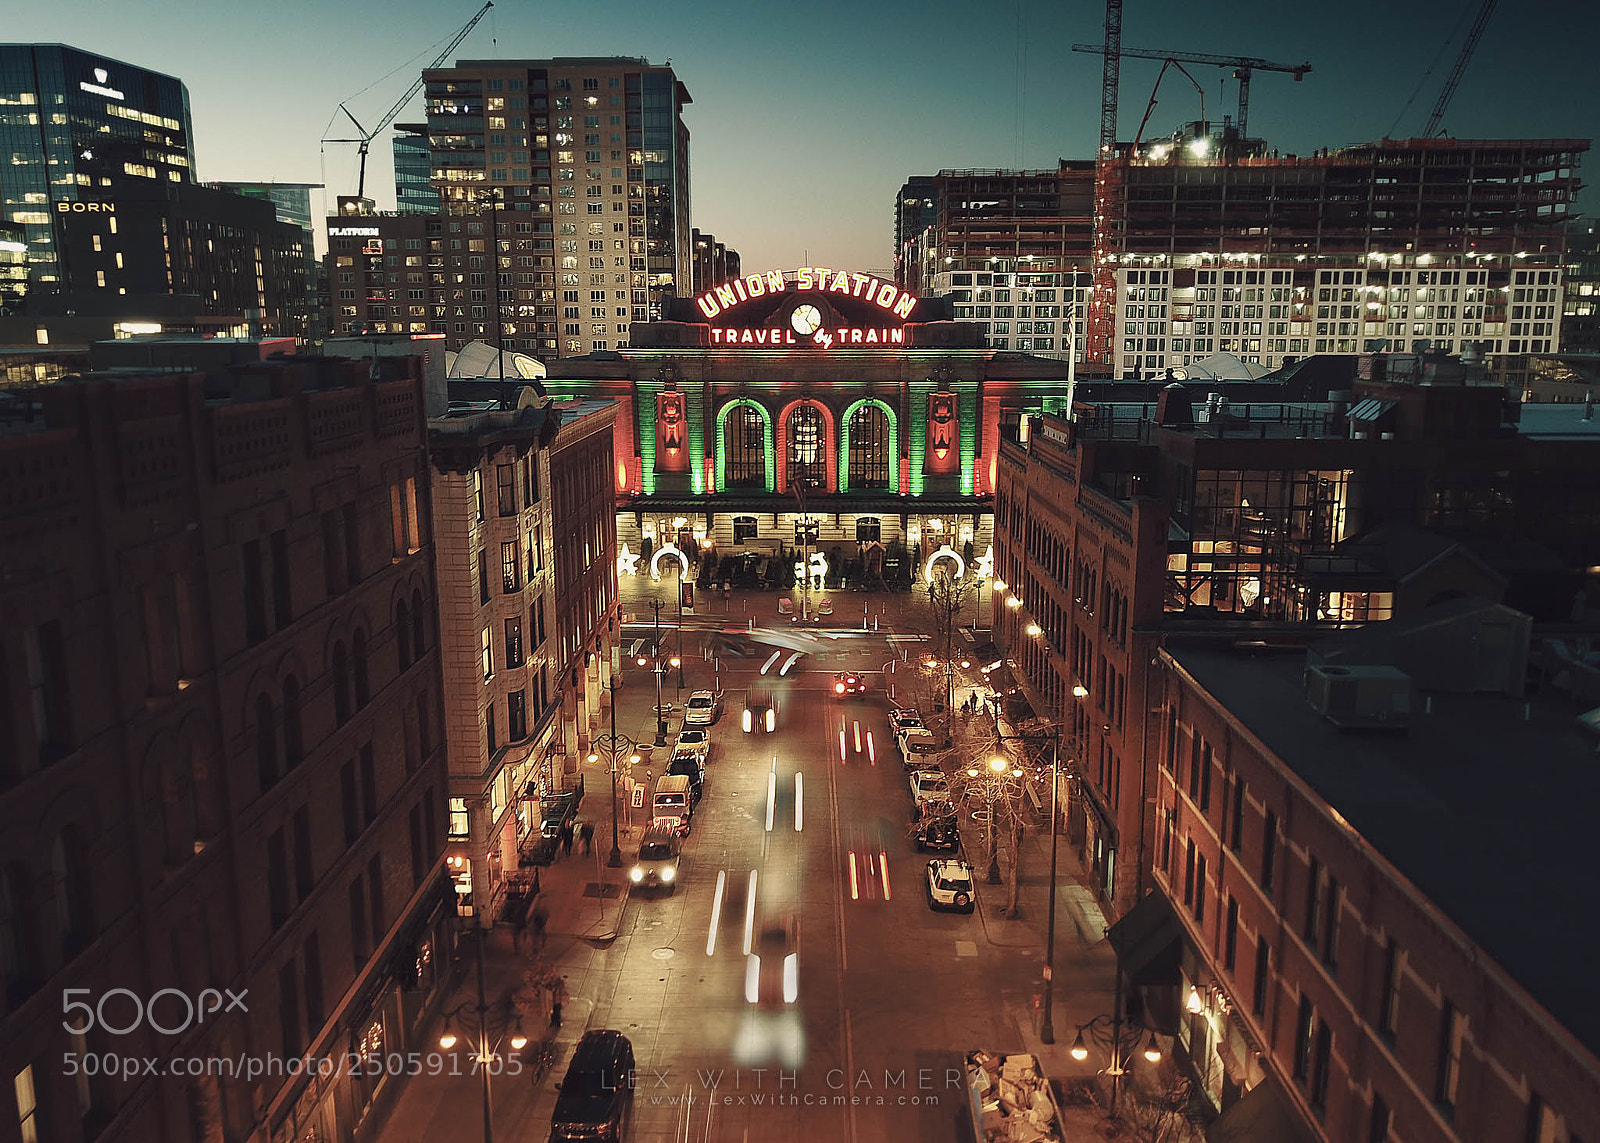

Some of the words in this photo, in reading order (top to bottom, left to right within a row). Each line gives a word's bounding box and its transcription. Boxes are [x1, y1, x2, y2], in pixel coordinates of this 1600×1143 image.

[58, 202, 115, 212] BORN
[328, 227, 380, 237] PLATFORM
[697, 269, 786, 319] UNION
[797, 267, 917, 320] STATION
[711, 328, 797, 344] TRAVEL
[813, 327, 833, 349] by
[837, 328, 903, 344] TRAIN
